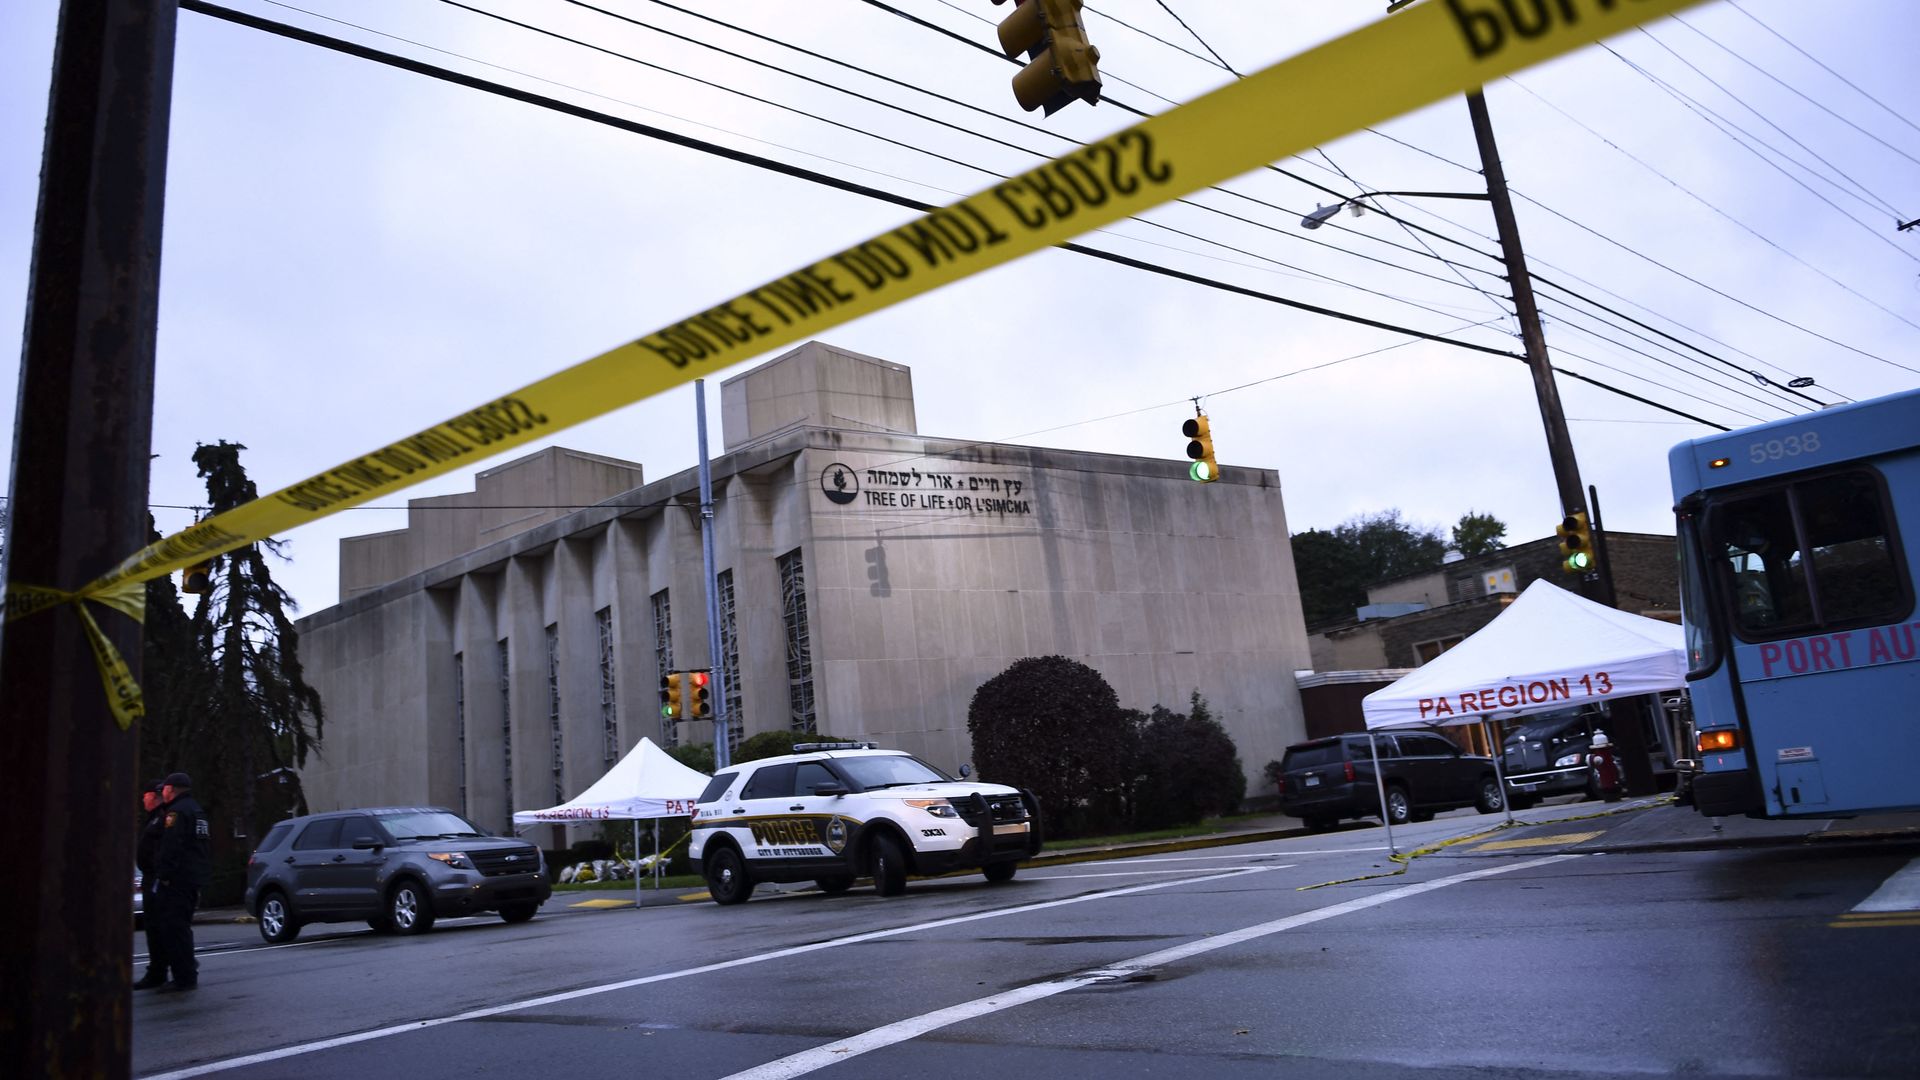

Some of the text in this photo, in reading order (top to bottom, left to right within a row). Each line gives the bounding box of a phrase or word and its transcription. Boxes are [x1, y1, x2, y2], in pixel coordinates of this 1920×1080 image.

[1750, 431, 1821, 464] 5938
[867, 467, 1022, 497] עץ חיים אור לשמחה
[864, 491, 1031, 514] TREE OF LIFE OR L'SIMCHA
[1760, 632, 1853, 677] PORT
[1418, 671, 1613, 719] PA REGION 13
[666, 800, 684, 815] PA
[195, 825, 209, 835] FIR
[748, 819, 821, 846] POLICE
[921, 828, 946, 837] 3X31
[757, 847, 824, 857] CITY OF PITTSBURGH
